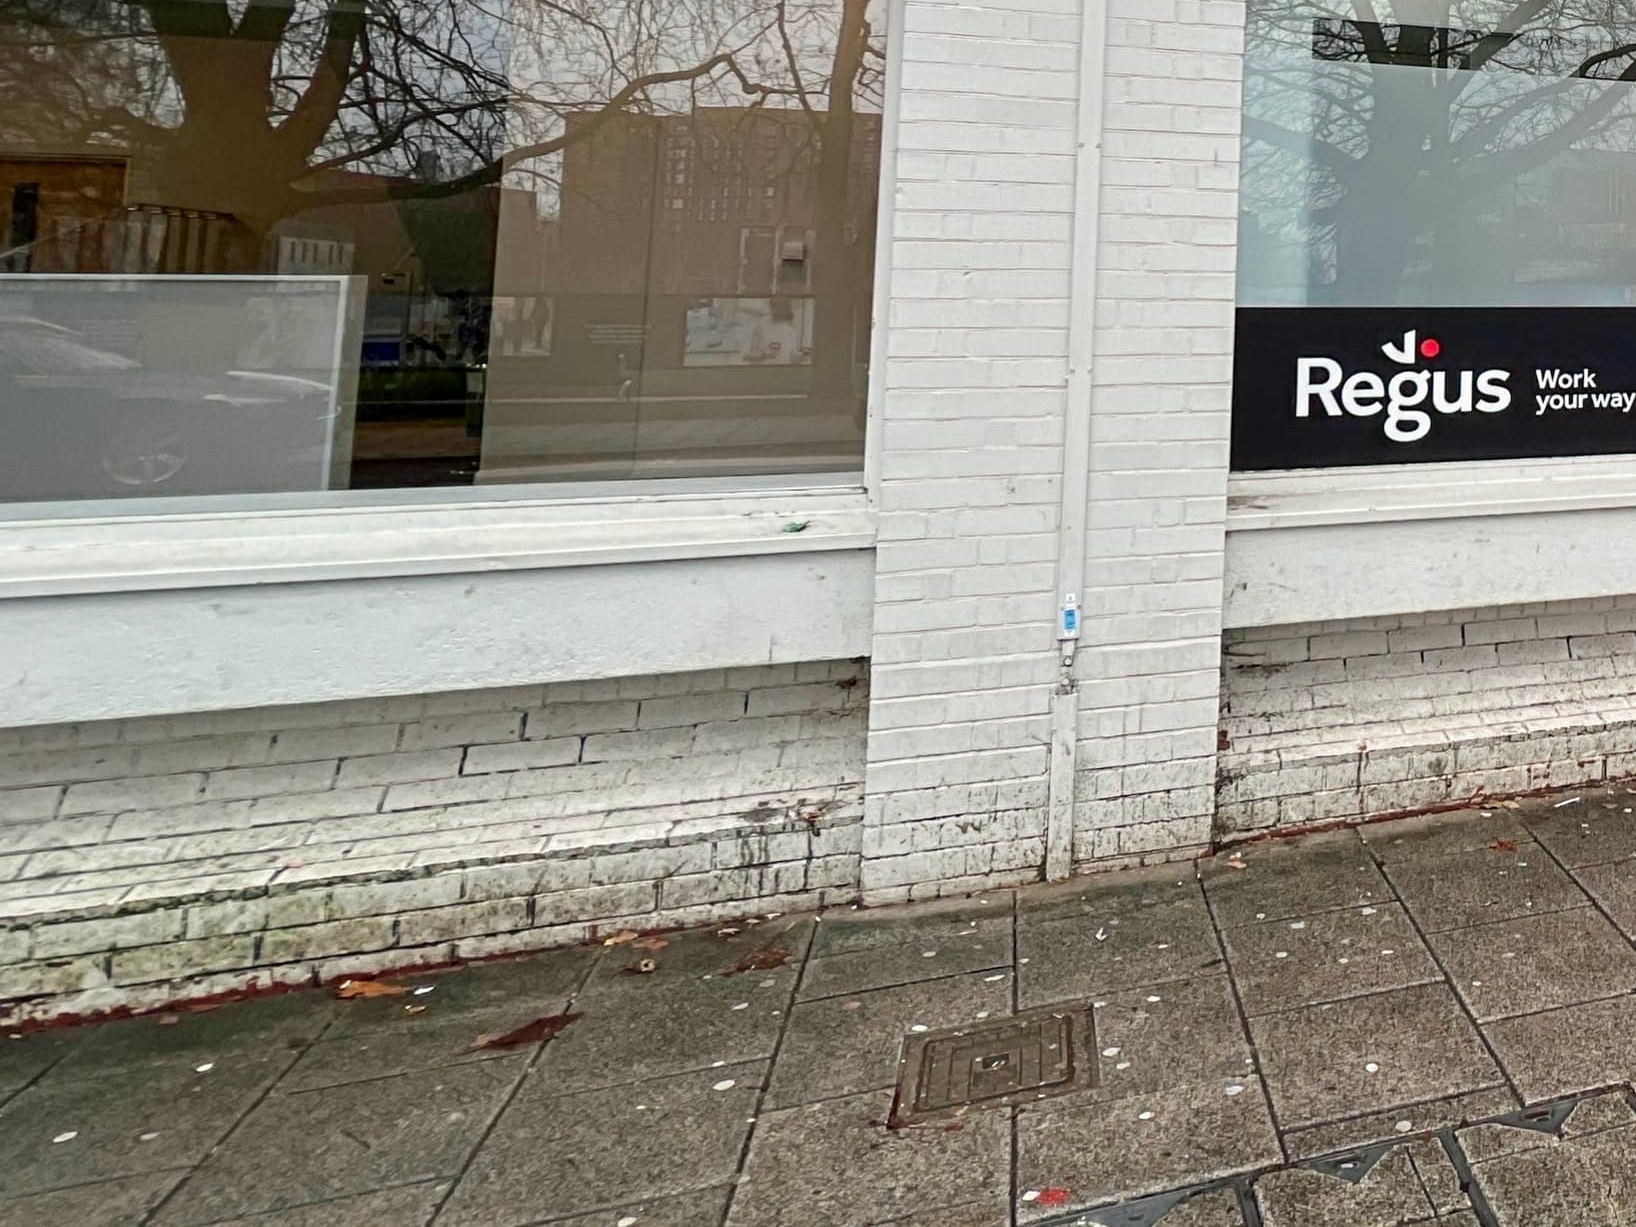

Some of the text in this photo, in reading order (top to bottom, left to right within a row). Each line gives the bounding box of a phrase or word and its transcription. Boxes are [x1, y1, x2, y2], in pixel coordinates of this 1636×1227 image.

[1535, 368, 1597, 390] Work
[1295, 356, 1511, 442] Regus
[1535, 391, 1636, 416] your way
